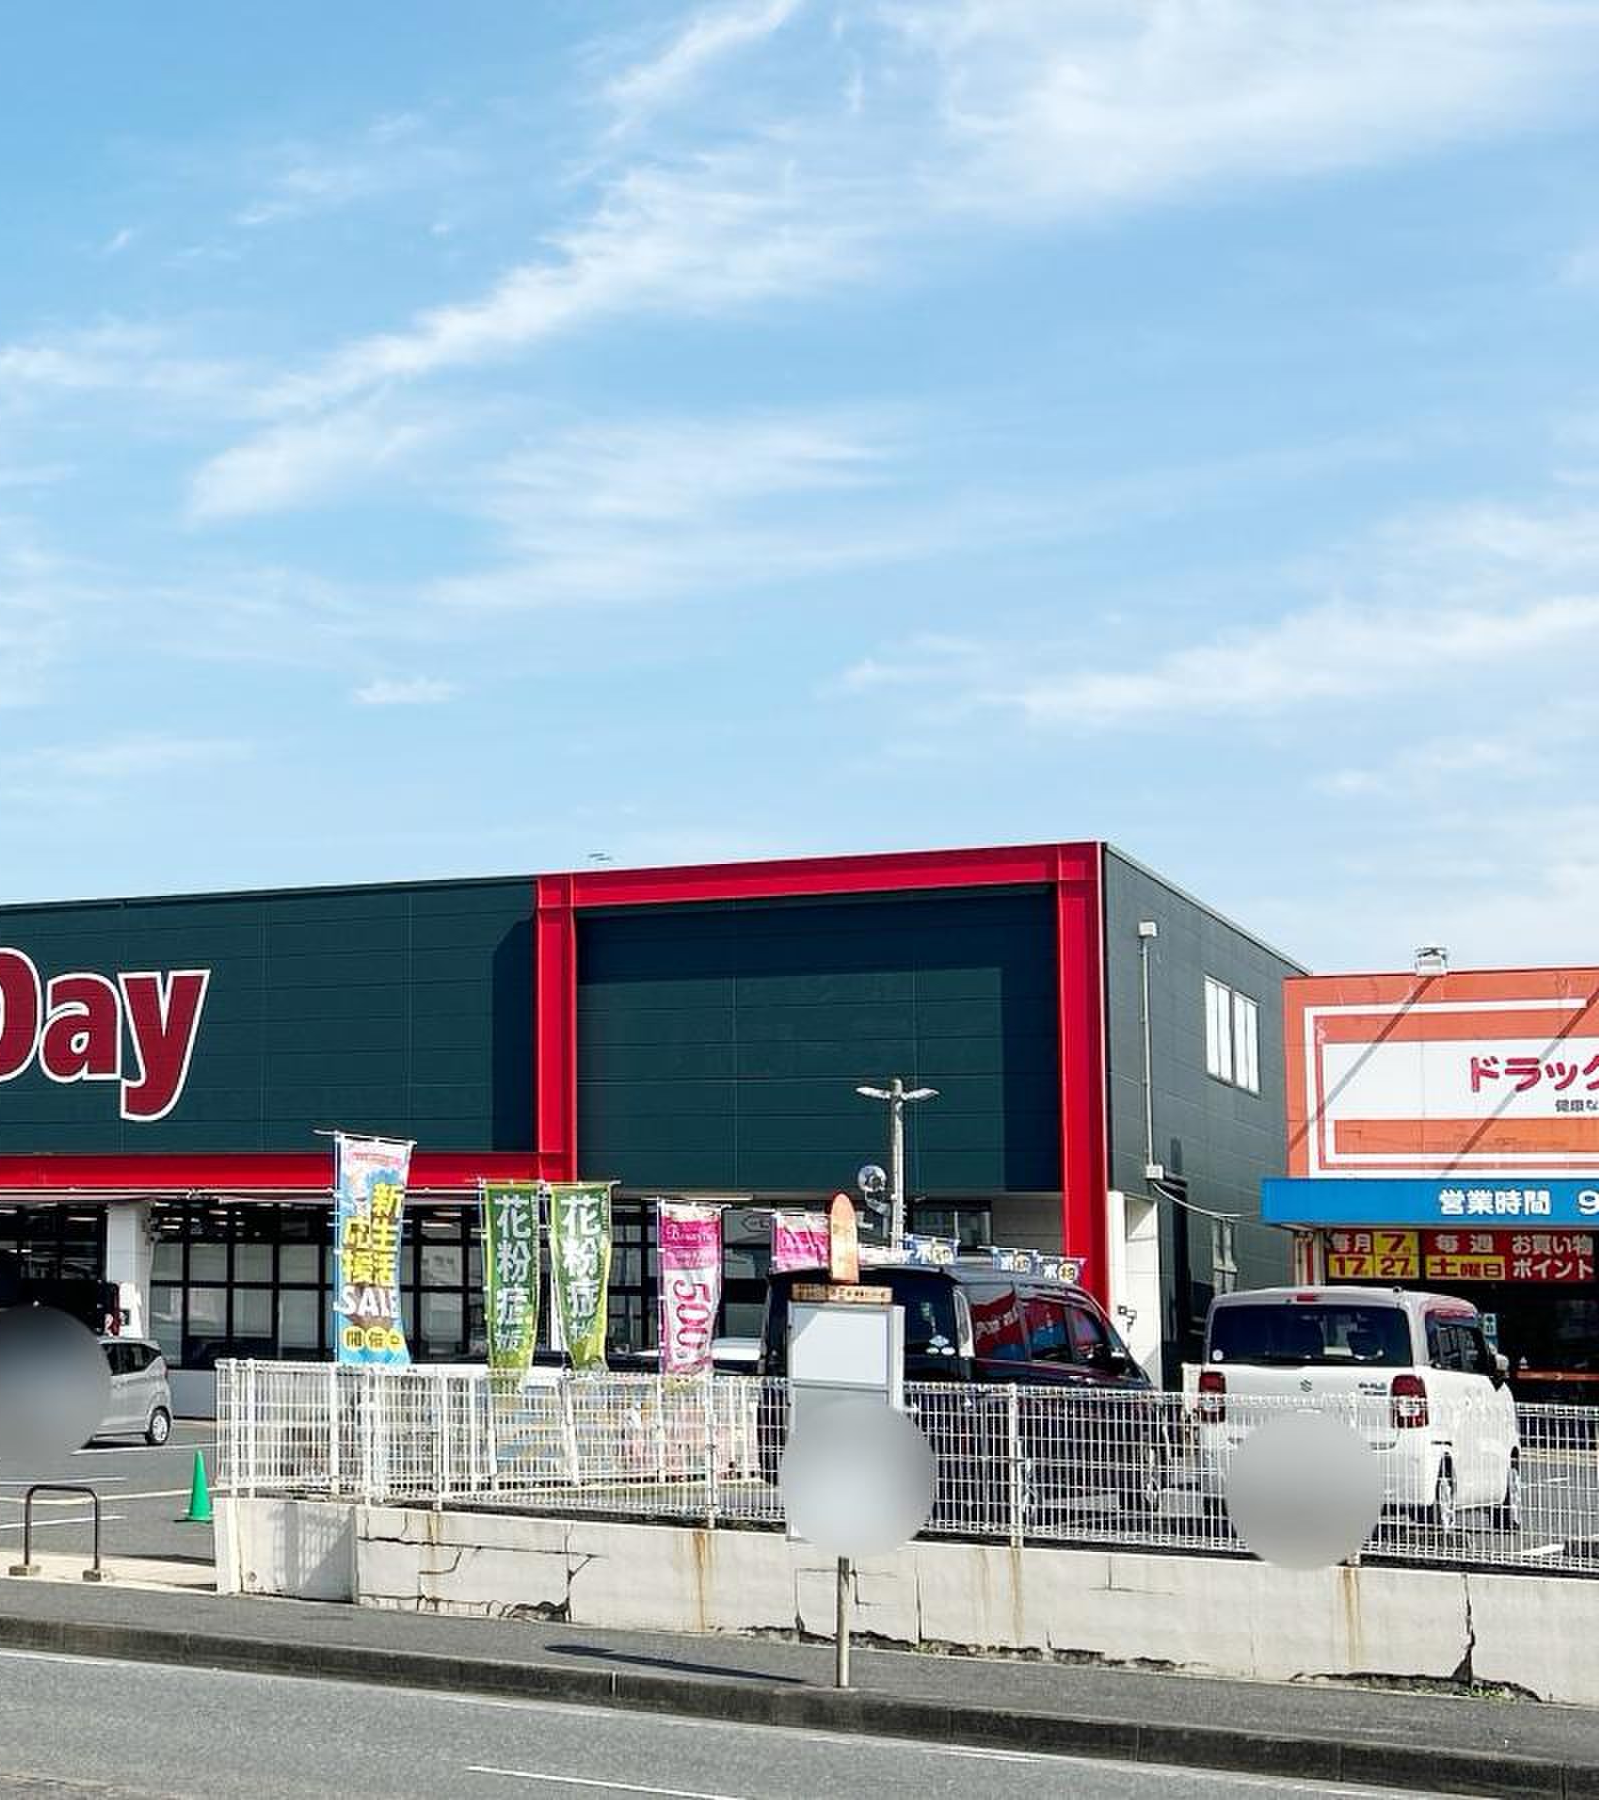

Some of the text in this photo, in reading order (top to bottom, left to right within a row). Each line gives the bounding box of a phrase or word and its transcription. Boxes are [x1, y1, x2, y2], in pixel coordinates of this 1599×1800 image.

[1438, 1188, 1552, 1216] 営業時間
[1511, 1234, 1594, 1256] お買い物
[1429, 1257, 1502, 1277] 土曜日
[1512, 1258, 1595, 1280] ポイント
